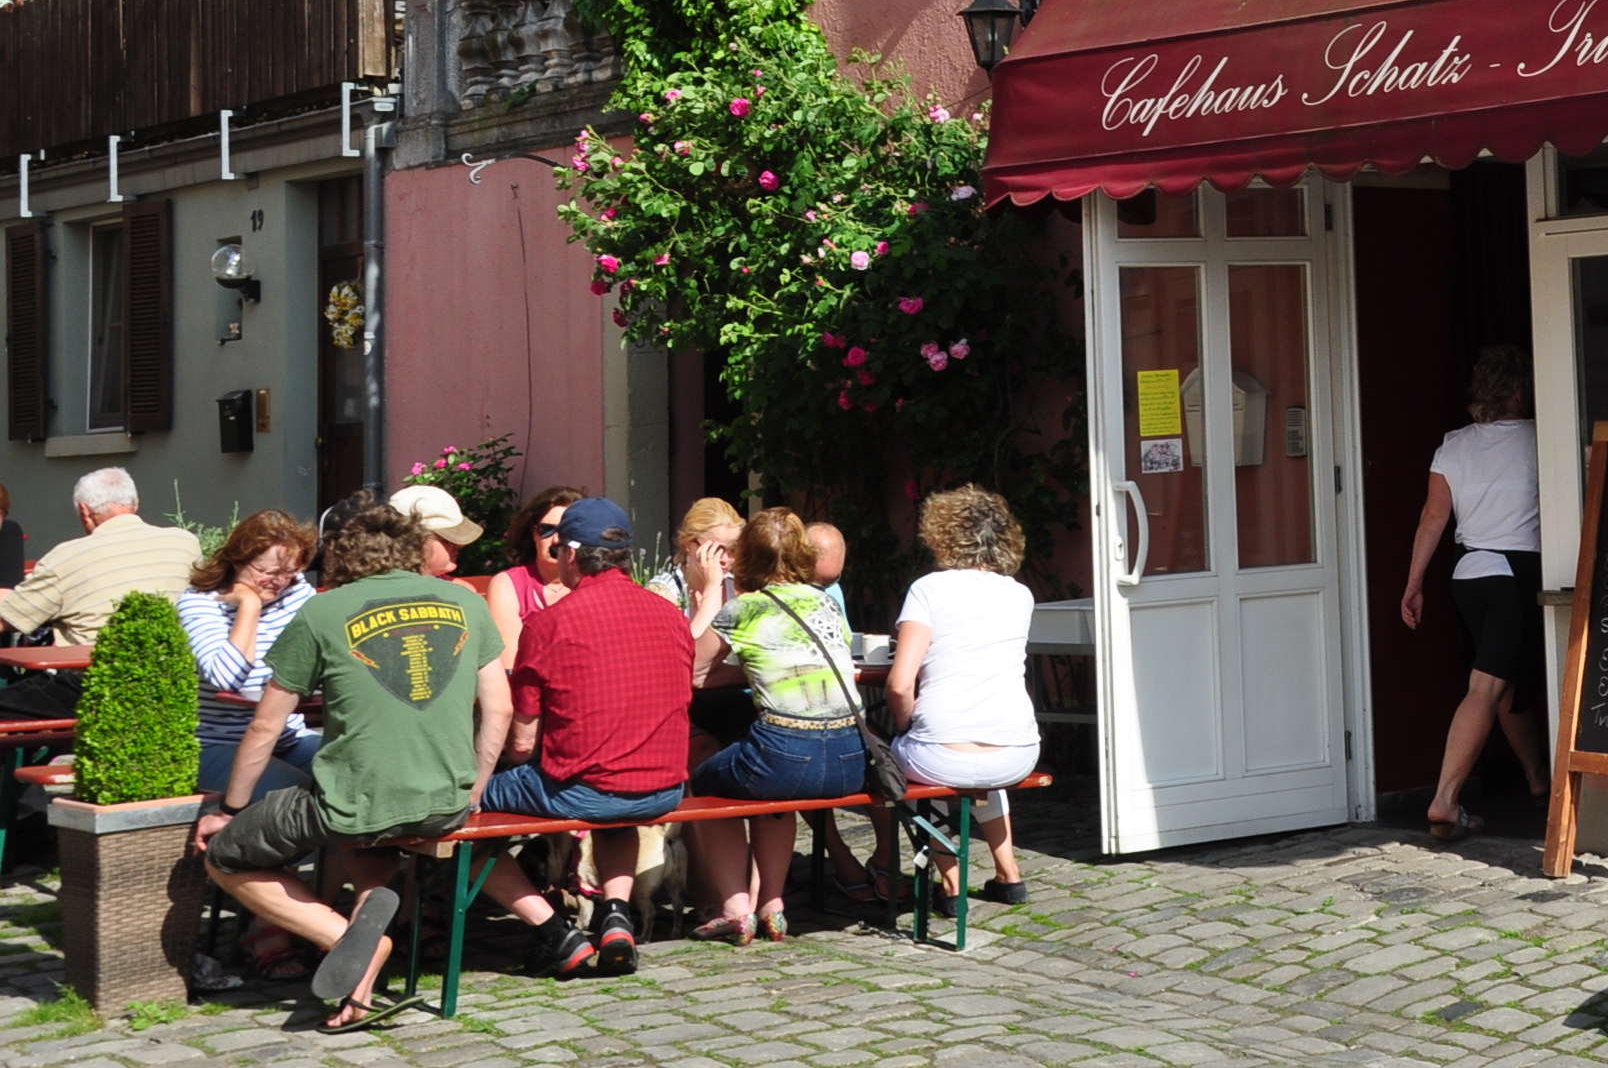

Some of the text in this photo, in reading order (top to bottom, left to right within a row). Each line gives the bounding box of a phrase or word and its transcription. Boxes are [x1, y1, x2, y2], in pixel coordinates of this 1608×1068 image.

[1101, 53, 1289, 137] Cafehaus
[1302, 20, 1473, 106] Schatz
[250, 209, 264, 232] 19
[351, 611, 397, 639] BLACK
[398, 606, 463, 623] SABBATH
